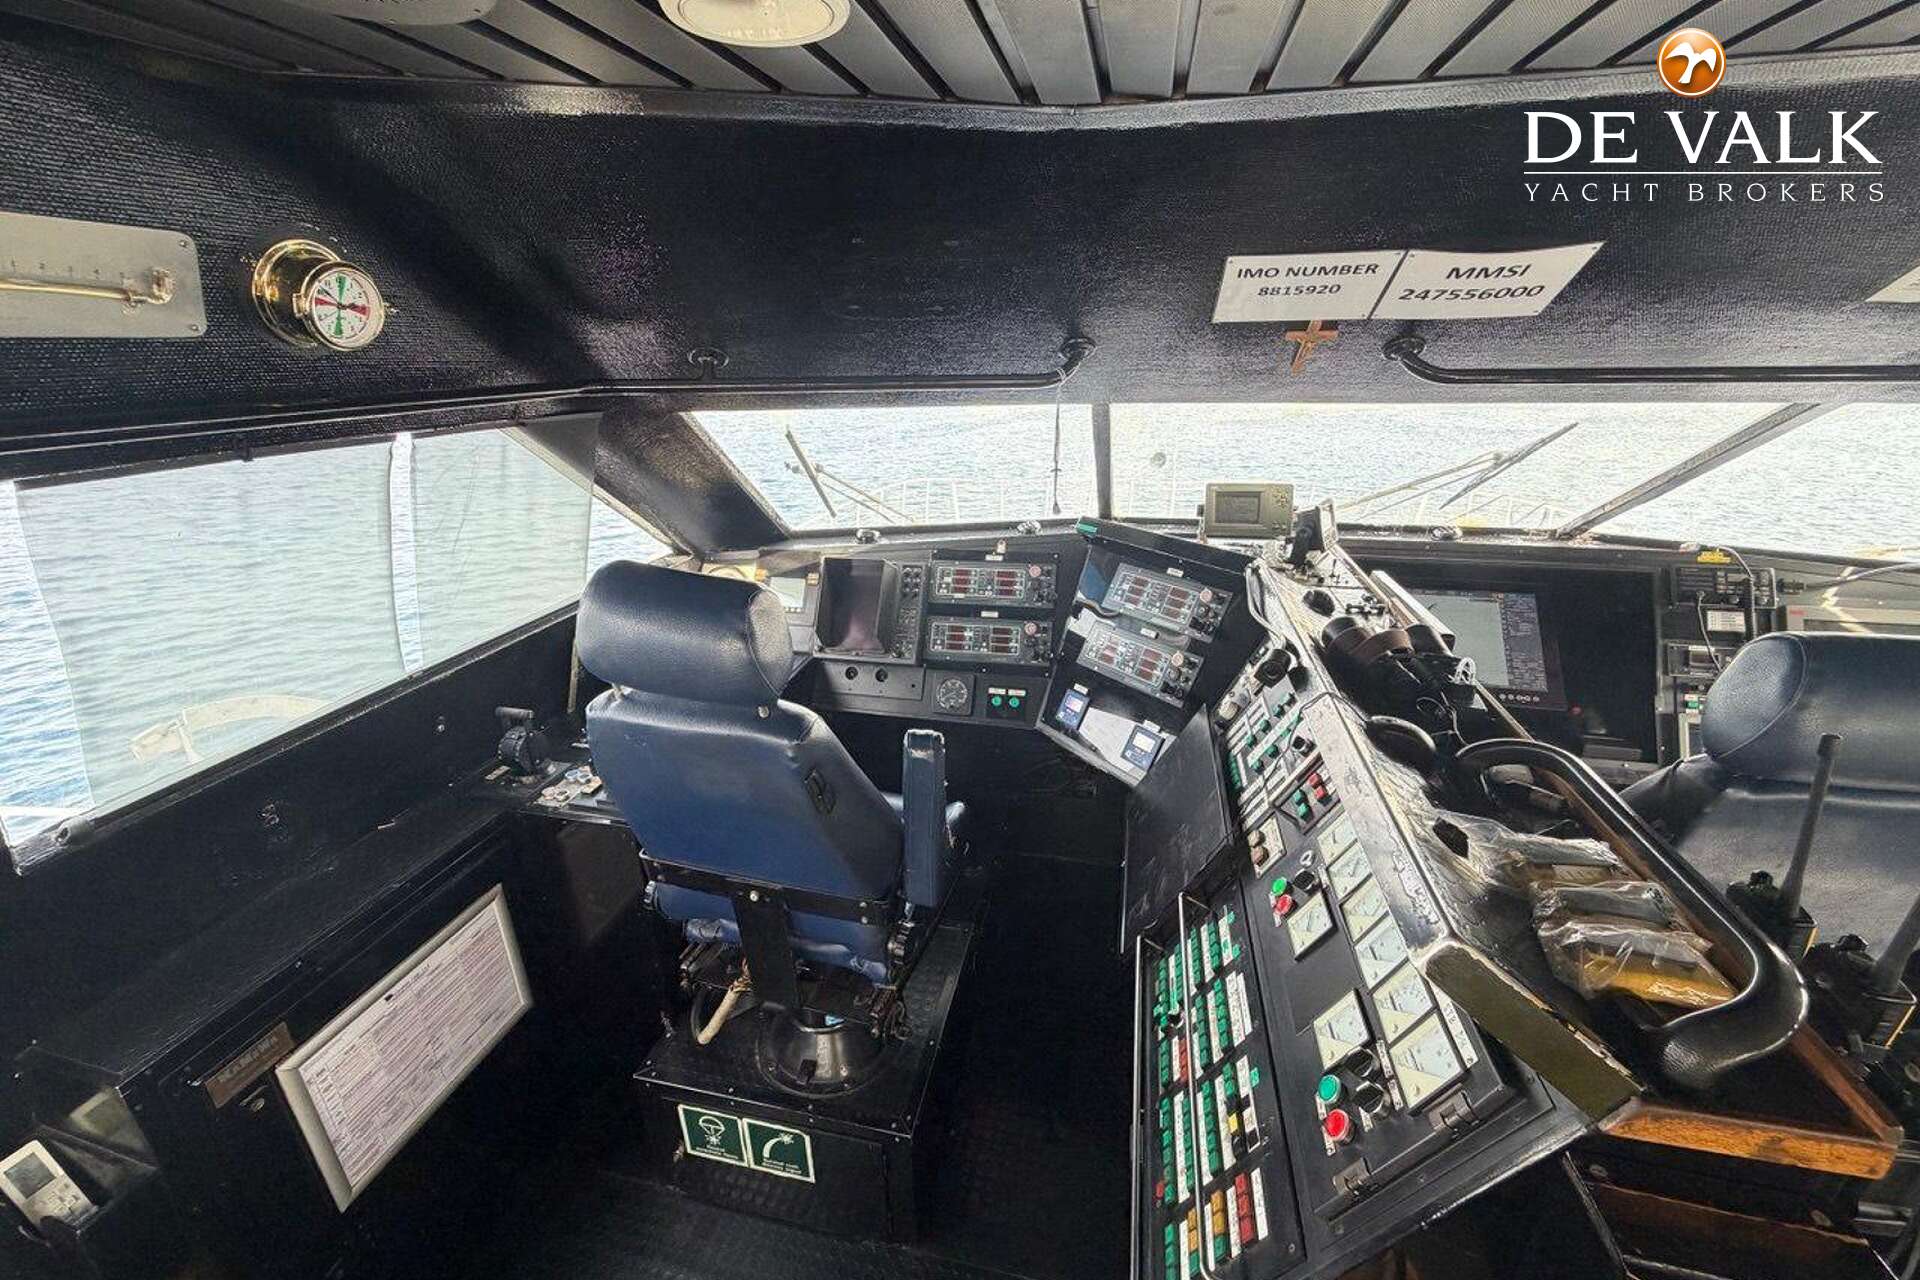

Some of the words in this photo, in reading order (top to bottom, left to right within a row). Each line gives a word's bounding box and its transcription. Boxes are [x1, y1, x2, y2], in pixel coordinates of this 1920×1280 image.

[1236, 267, 1280, 279] IMO
[1285, 263, 1381, 277] NUMBER
[1444, 263, 1533, 280] MMSI
[1256, 283, 1342, 297] 8815920
[1397, 284, 1547, 301] 247556000
